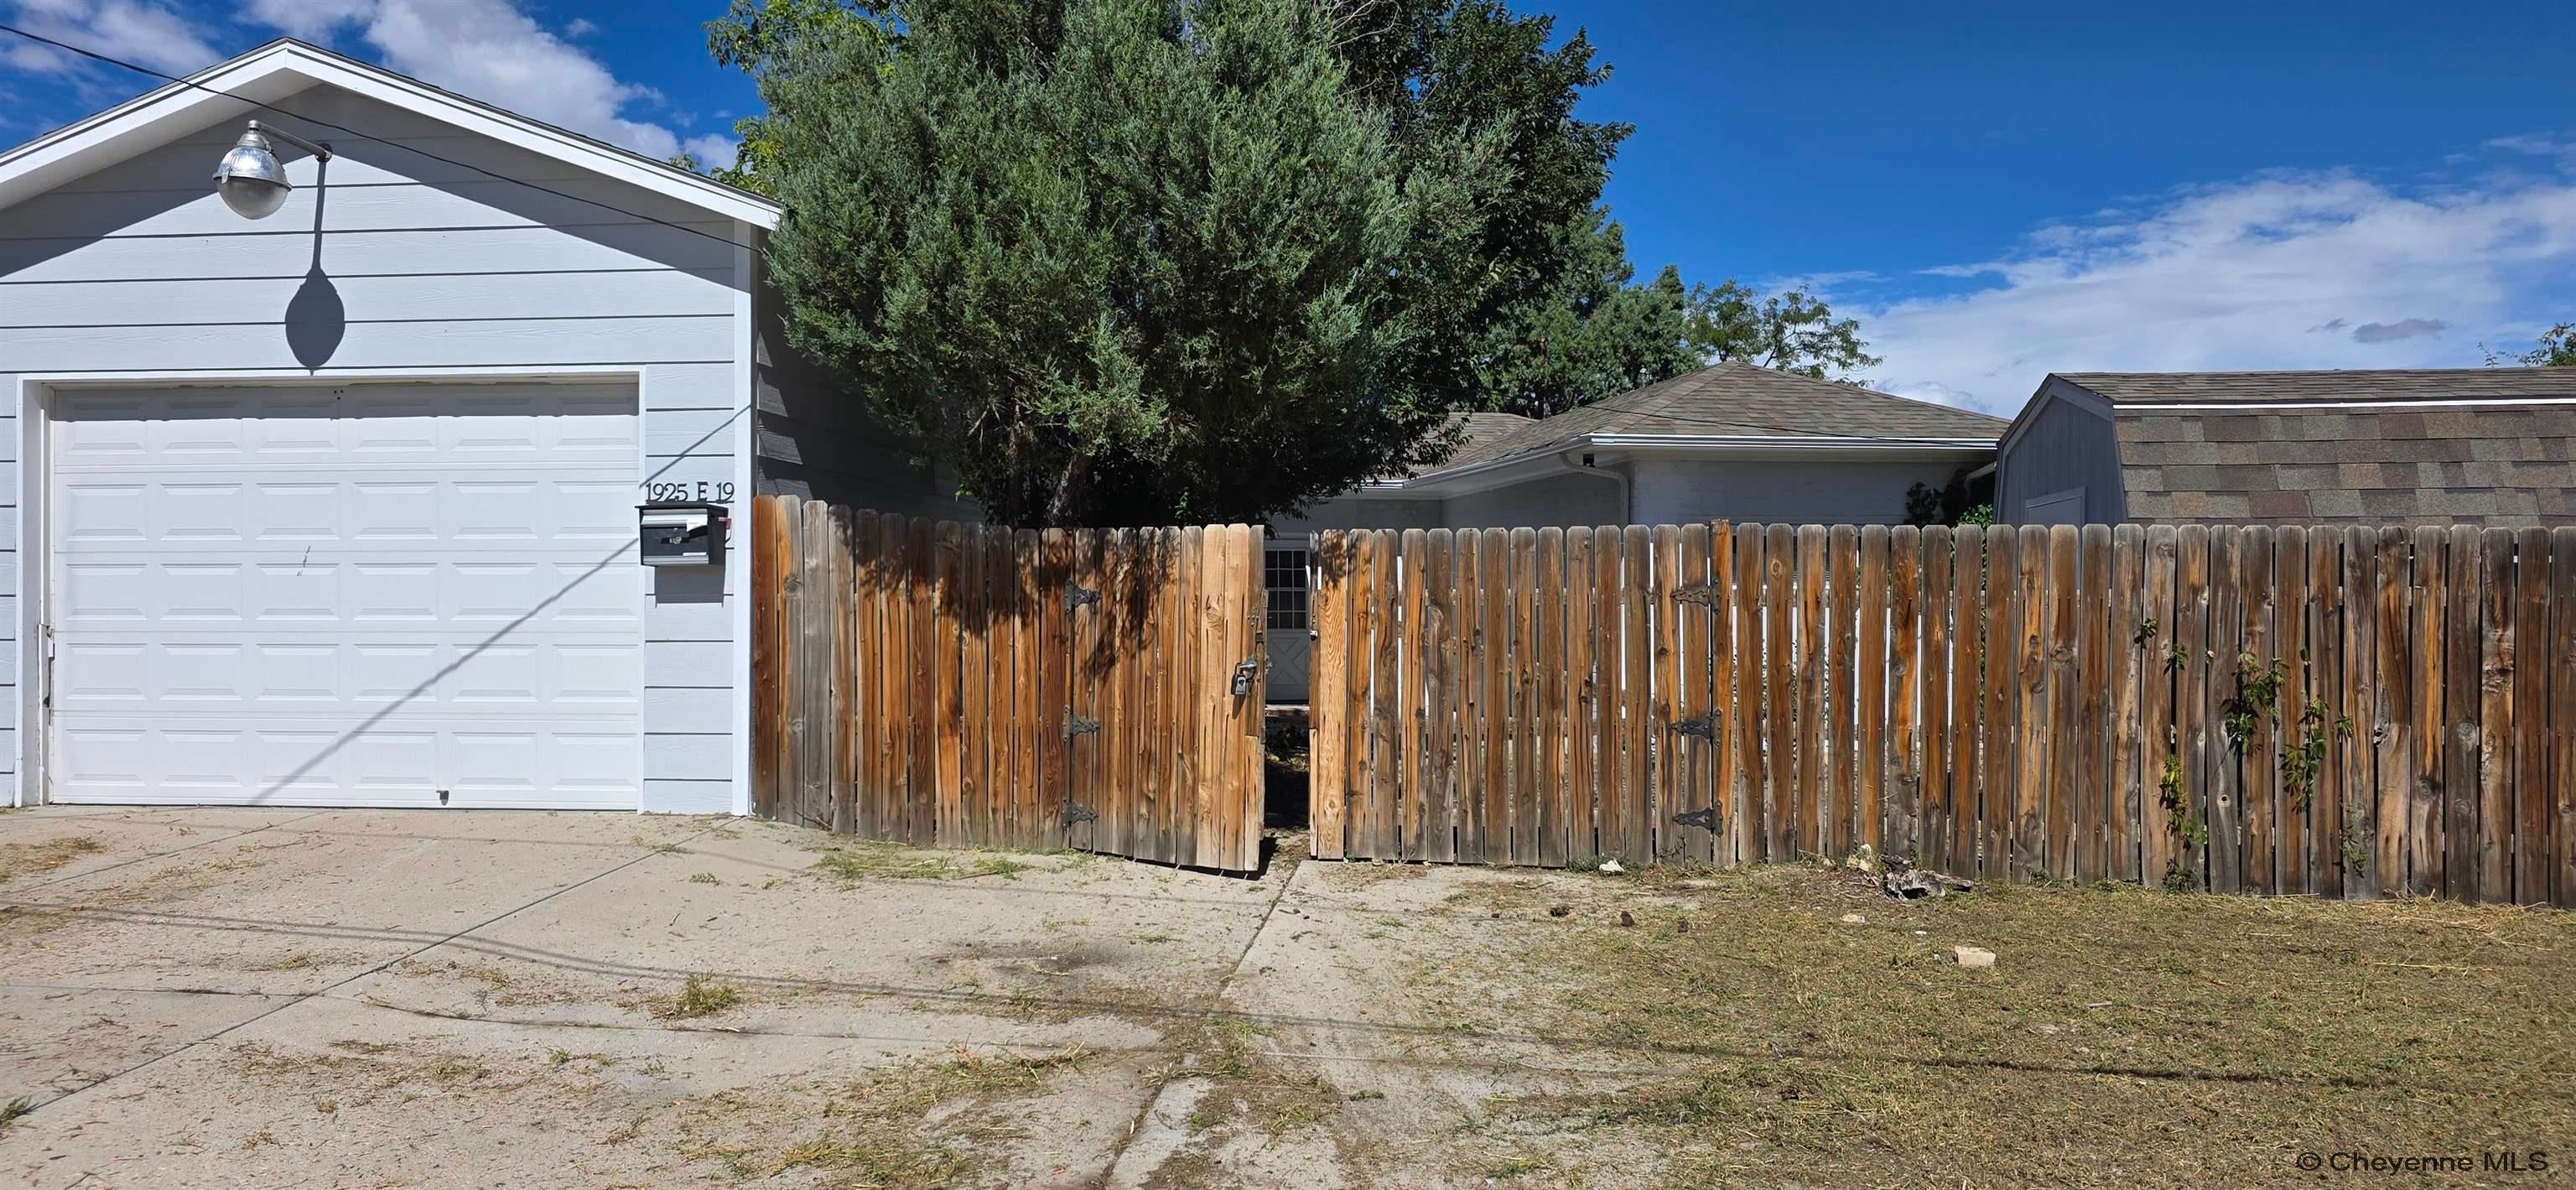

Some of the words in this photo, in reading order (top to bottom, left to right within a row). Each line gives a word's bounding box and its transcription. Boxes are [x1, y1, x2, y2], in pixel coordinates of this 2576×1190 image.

[645, 482, 688, 502] 1925
[697, 481, 709, 501] E
[716, 482, 735, 503] 19
